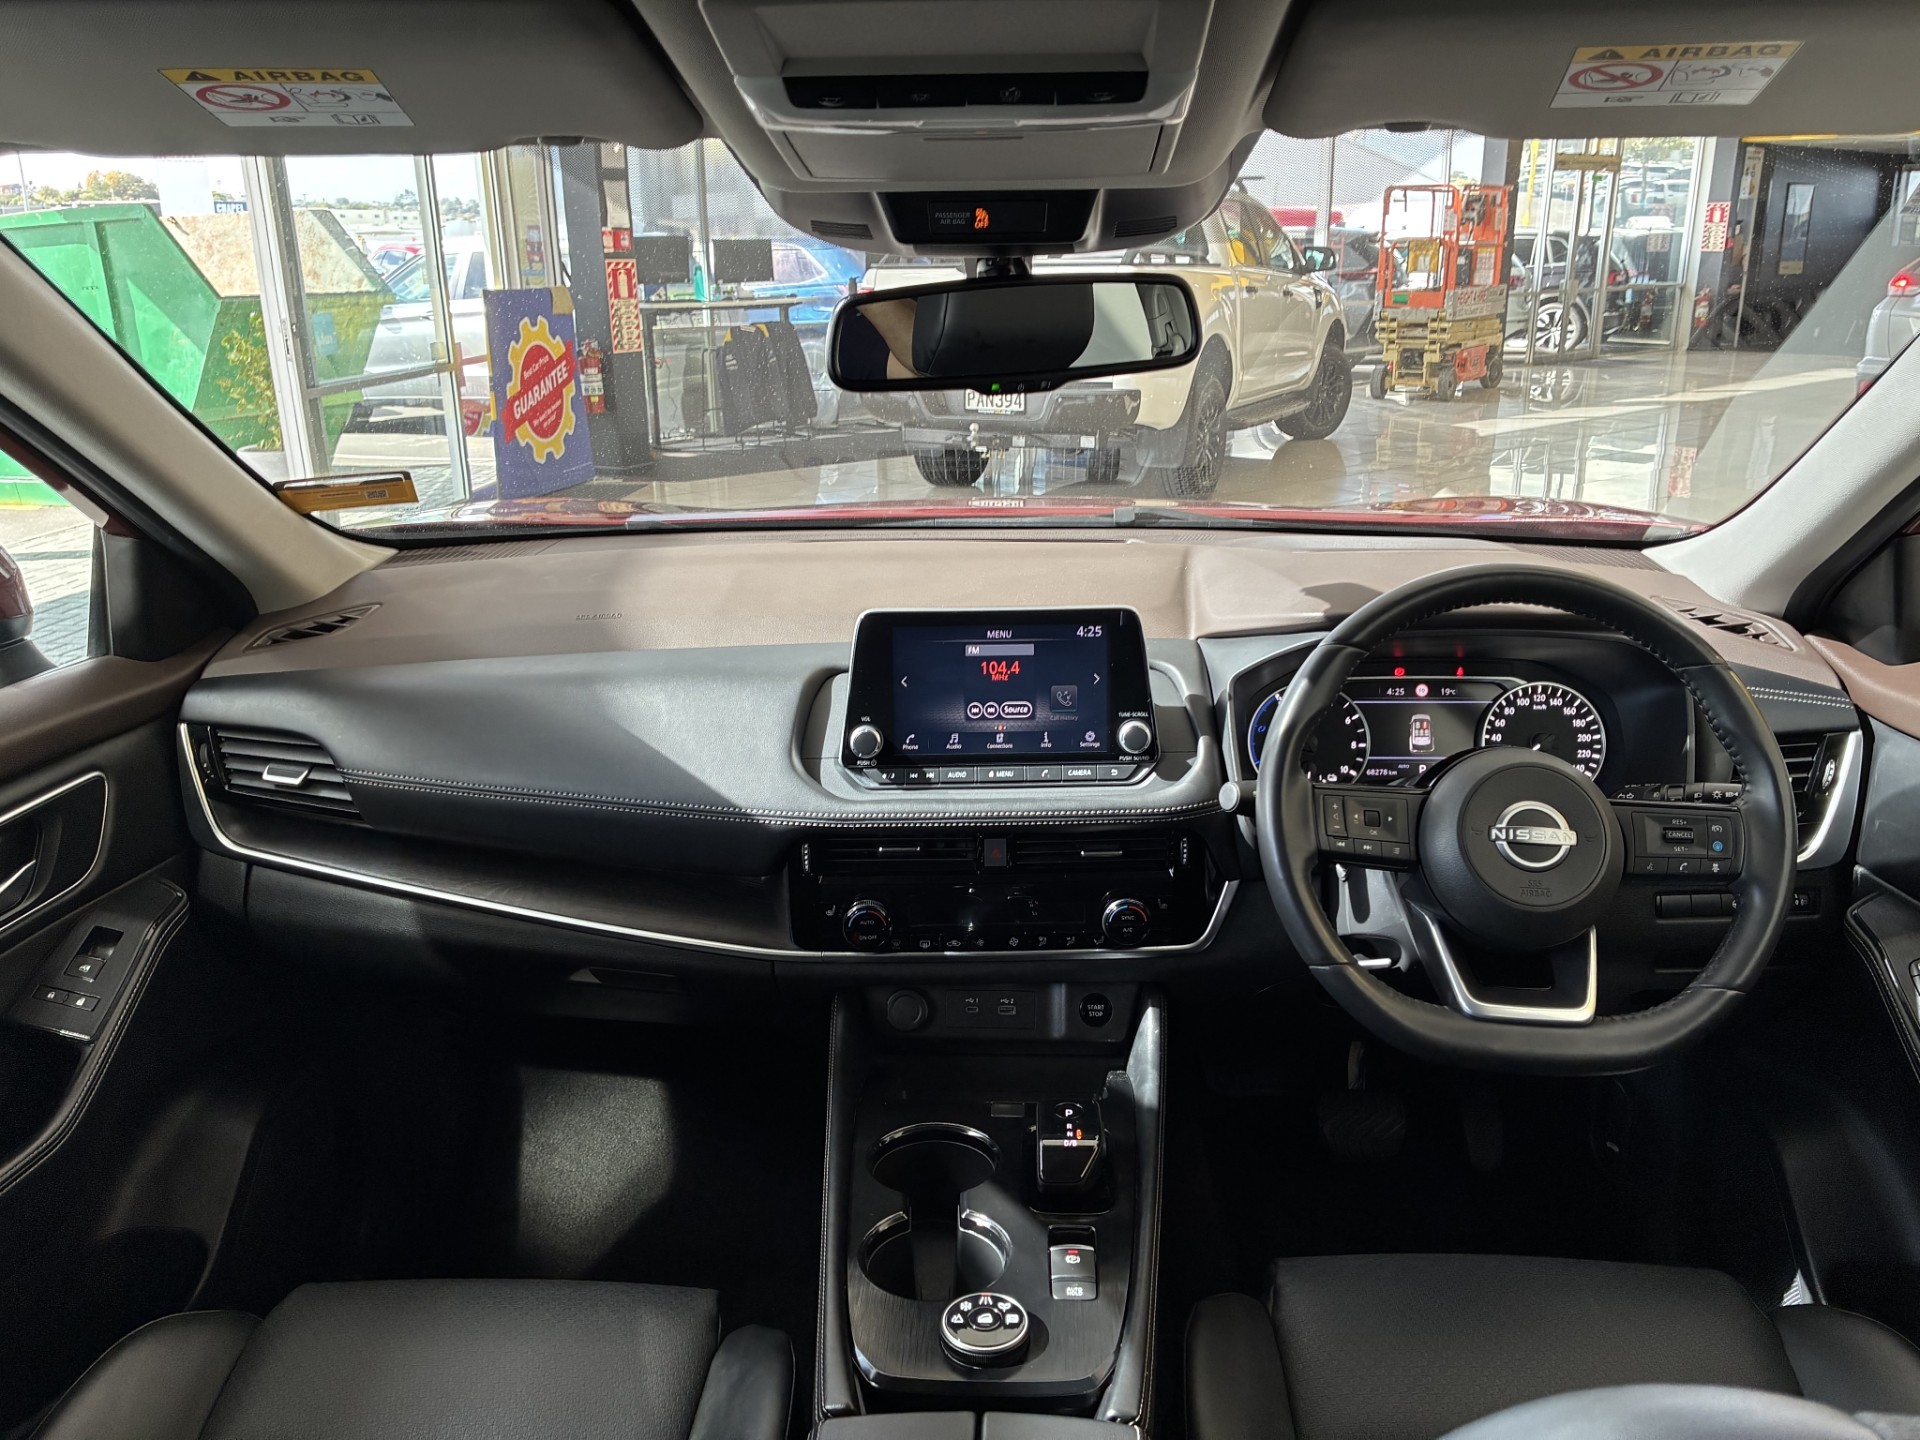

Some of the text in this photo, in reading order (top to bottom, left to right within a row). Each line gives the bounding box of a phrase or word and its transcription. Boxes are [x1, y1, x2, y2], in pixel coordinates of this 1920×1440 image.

[1639, 44, 1782, 58] AIRBAG
[234, 70, 365, 82] AIRBAG
[974, 220, 989, 229] OFF
[513, 360, 569, 420] GUARANTEE
[966, 391, 1023, 409] PAN394
[986, 629, 1012, 639] MENU
[1076, 625, 1102, 637] 4:25
[967, 646, 980, 655] FM
[980, 660, 1020, 675] 104.4
[1386, 687, 1405, 695] 4:25
[1516, 698, 1530, 706] 100
[1533, 694, 1546, 702] 120
[1550, 698, 1563, 706] 140
[1004, 705, 1028, 713] Source
[1504, 707, 1515, 715] 80
[1563, 707, 1577, 715] 160
[1344, 717, 1351, 725] 6
[1494, 719, 1506, 727] 60
[1572, 719, 1586, 727] 180
[1490, 733, 1502, 742] 40
[1577, 733, 1592, 742] 200
[1350, 741, 1357, 749] 8
[1576, 750, 1591, 758] 220
[1339, 765, 1349, 774] 10
[1366, 768, 1388, 776] 68278
[1418, 764, 1427, 774] P
[1491, 828, 1575, 843] NISSAN
[1520, 889, 1552, 898] AIRBAG
[859, 918, 875, 926] AUTO
[1065, 1109, 1074, 1117] P
